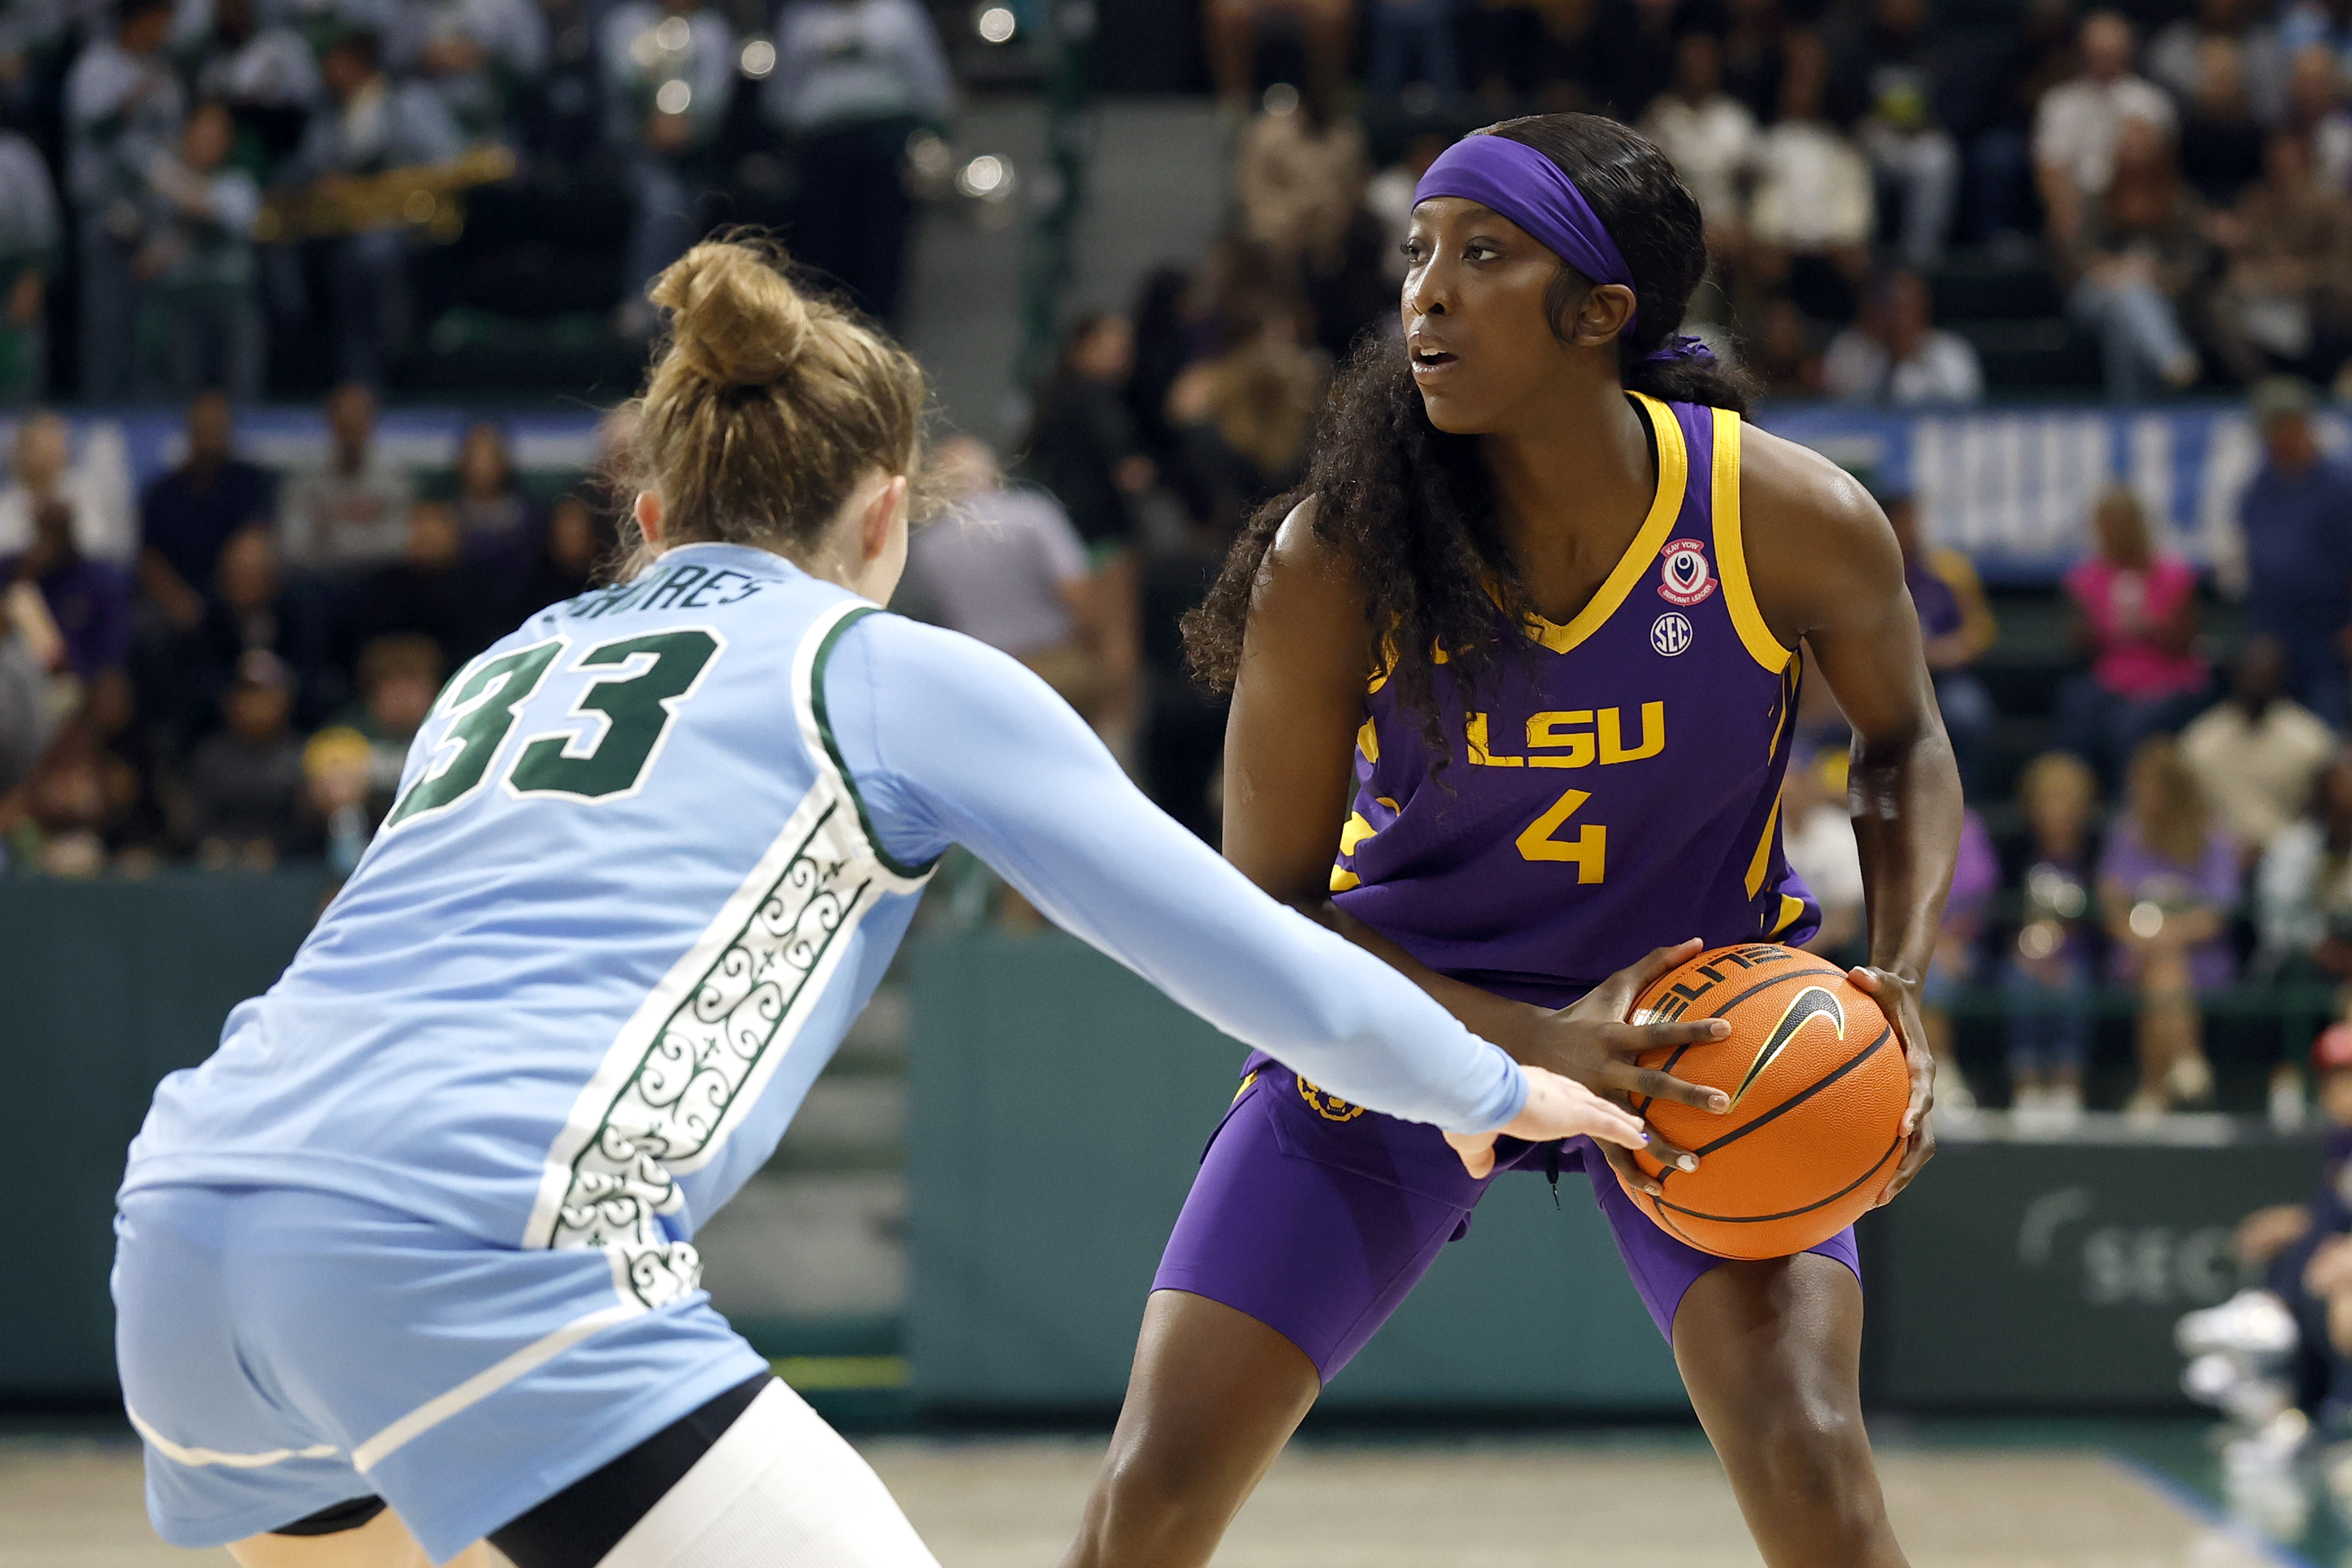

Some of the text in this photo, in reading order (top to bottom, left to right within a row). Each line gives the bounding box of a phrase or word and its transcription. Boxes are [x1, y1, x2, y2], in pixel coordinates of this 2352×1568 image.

[1665, 541, 1699, 555] KAY YOW
[1663, 584, 1712, 603] SERVANT LEADER
[1655, 617, 1688, 652] SEC
[381, 624, 728, 832] 33
[1466, 701, 1664, 768] LSU
[1514, 788, 1608, 884] 4
[1642, 946, 1793, 1023] ELITE
